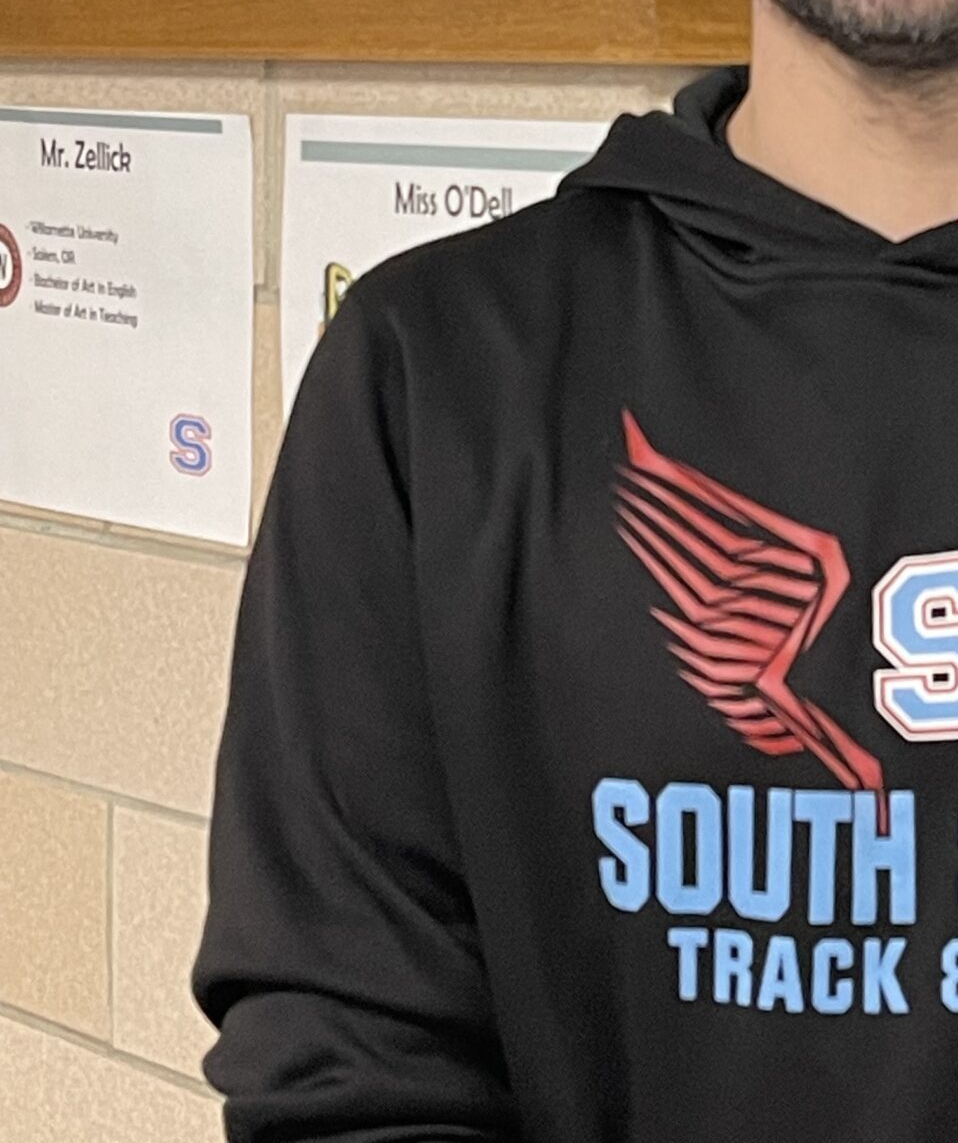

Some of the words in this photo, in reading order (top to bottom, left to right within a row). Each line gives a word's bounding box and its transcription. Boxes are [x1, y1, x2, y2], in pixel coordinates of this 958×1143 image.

[40, 138, 69, 168] Mr.
[74, 140, 131, 173] Zellick
[394, 182, 437, 216] Miss
[444, 185, 513, 221] O'Dell
[77, 225, 119, 245] University
[61, 250, 76, 265] OR
[34, 273, 69, 290] Bachelor
[71, 278, 80, 291] of
[82, 279, 95, 294] Art
[97, 282, 106, 294] in
[107, 281, 137, 299] English
[34, 300, 61, 316] Master
[63, 304, 73, 317] of
[74, 304, 88, 319] Art
[89, 308, 98, 320] in
[99, 308, 138, 329] Teaching
[168, 413, 213, 477] S
[592, 777, 917, 926] SOUTH
[668, 927, 909, 1014] TRACK
